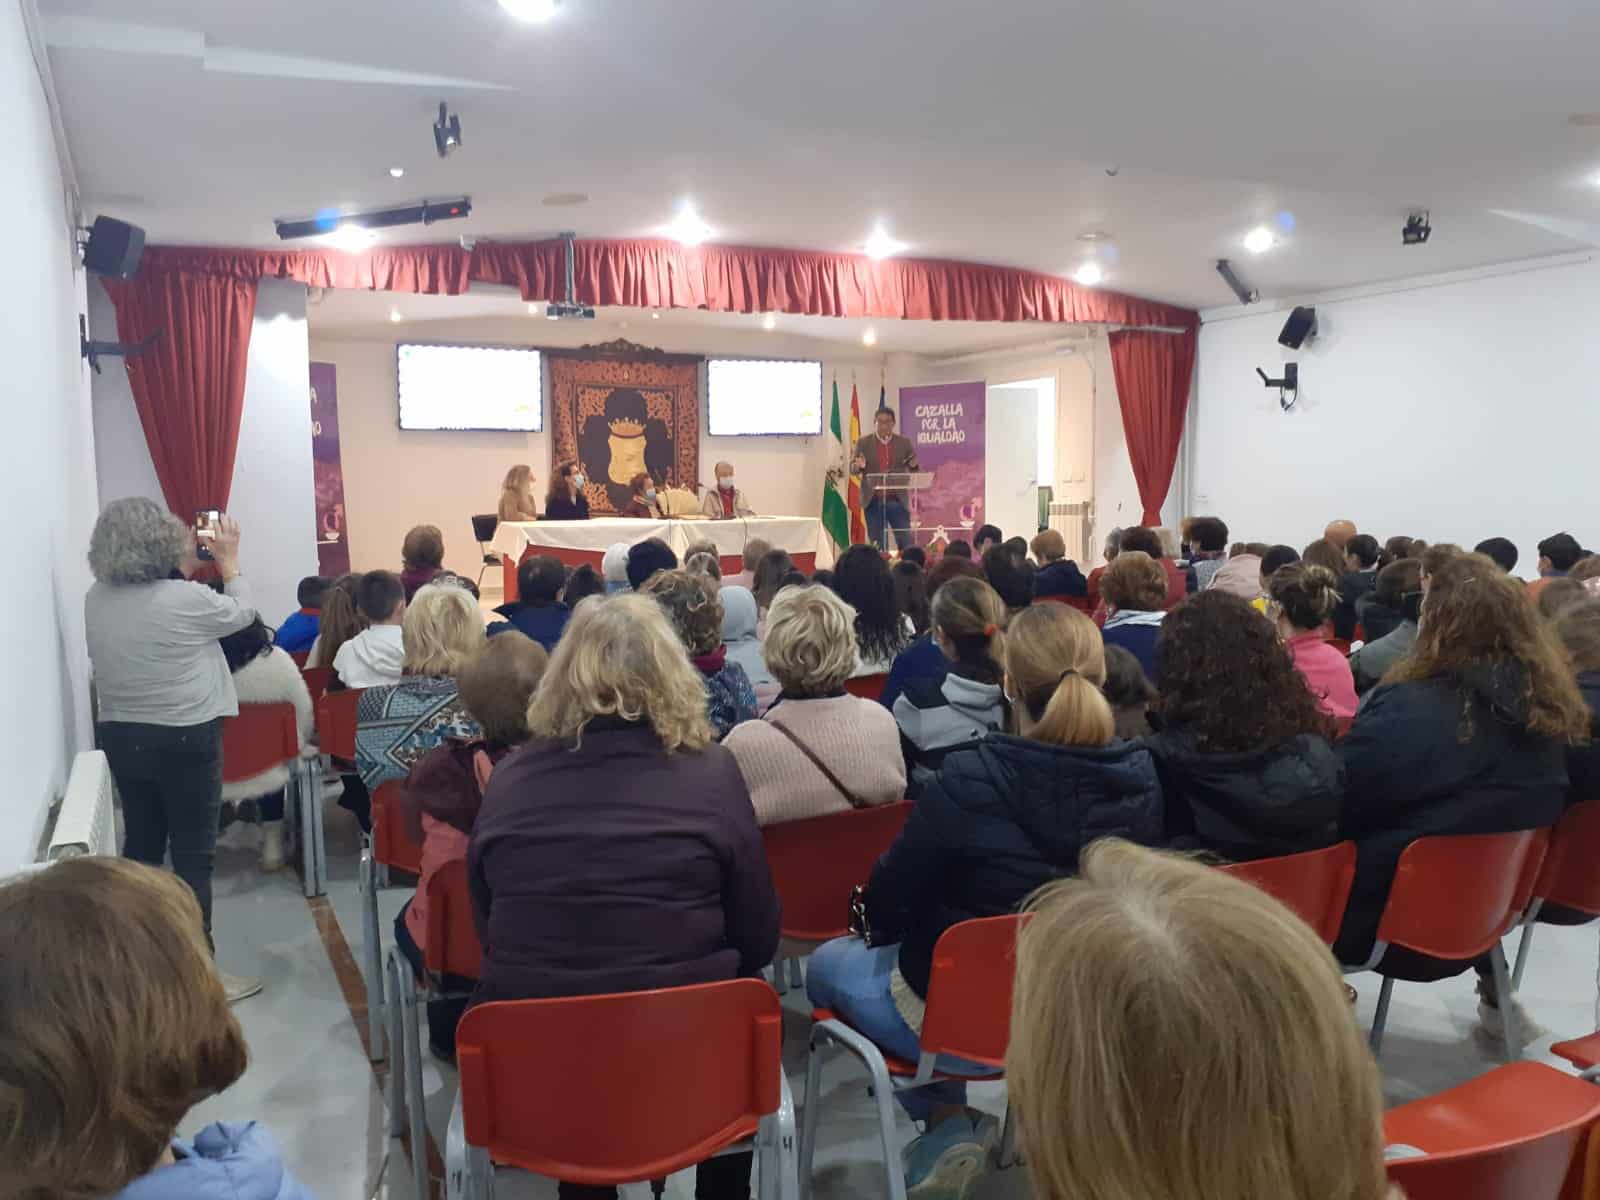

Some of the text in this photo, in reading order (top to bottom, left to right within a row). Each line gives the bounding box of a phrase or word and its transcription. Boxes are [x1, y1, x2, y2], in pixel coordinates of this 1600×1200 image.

[915, 403, 963, 418] CAZALLA
[921, 417, 956, 431] POR LA
[917, 430, 966, 445] IGUALDAD
